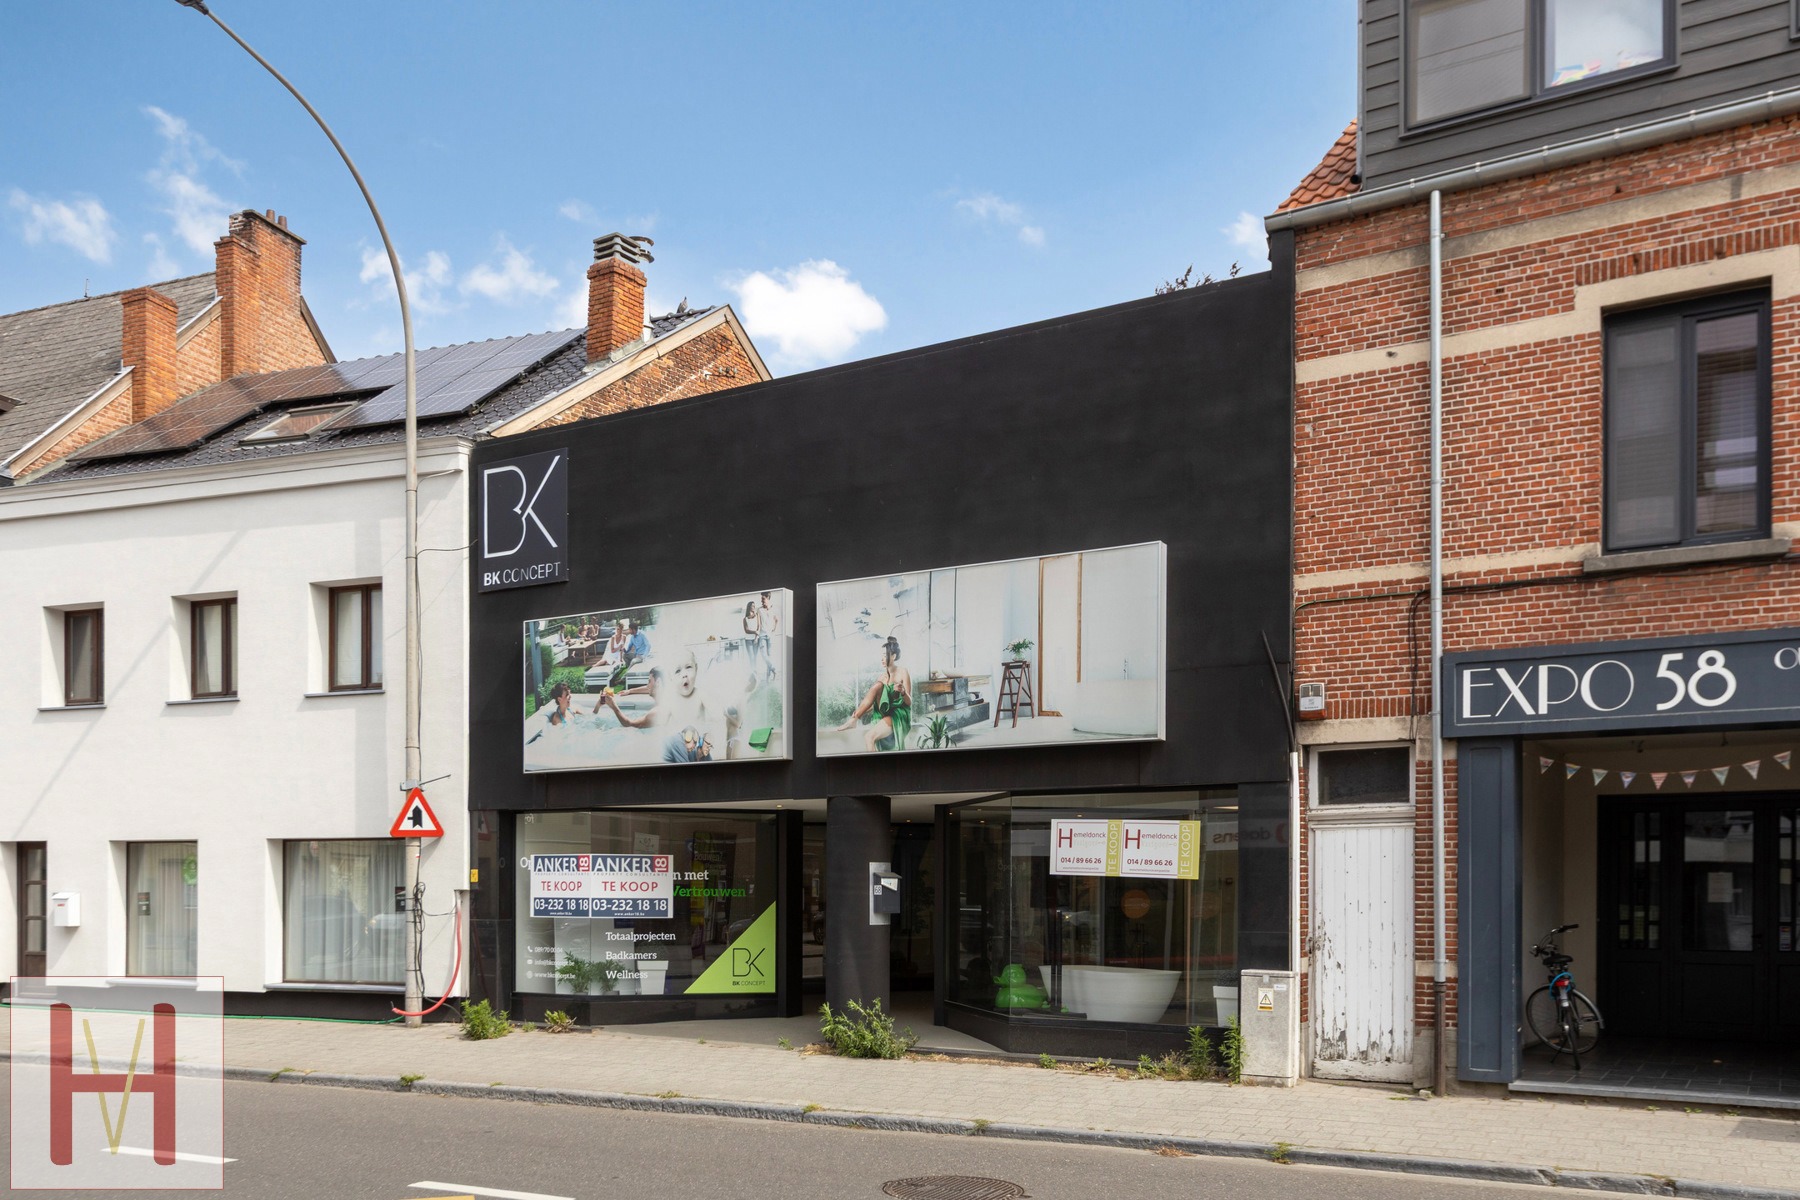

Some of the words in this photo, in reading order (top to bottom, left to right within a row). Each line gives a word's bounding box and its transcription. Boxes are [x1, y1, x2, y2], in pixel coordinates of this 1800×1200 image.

[483, 454, 561, 559] BK
[483, 571, 501, 587] BK
[502, 562, 561, 584] CONCEPT
[1462, 660, 1635, 719] EXPO
[1656, 649, 1737, 711] 58
[1108, 823, 1118, 855] KOOP
[1181, 825, 1191, 857] KOOP
[535, 857, 578, 872] ANKER
[578, 857, 589, 872] 18
[593, 857, 652, 872] ANKER
[654, 857, 667, 872] 18
[1107, 857, 1117, 872] TE
[1180, 860, 1190, 874] TE
[684, 869, 709, 880] met
[541, 881, 551, 891] TE
[554, 881, 582, 891] KOOP
[602, 881, 616, 892] TE
[620, 881, 658, 892] KOOP
[534, 899, 564, 910] 03-232
[566, 899, 576, 911] 18
[578, 899, 589, 911] 18
[592, 899, 633, 911] 03-232
[636, 899, 650, 911] 18
[653, 899, 667, 911] 18
[605, 931, 676, 942] Totaalprojecten
[605, 951, 657, 960] Badkamers
[732, 947, 766, 977] BK
[605, 970, 648, 979] Wellness
